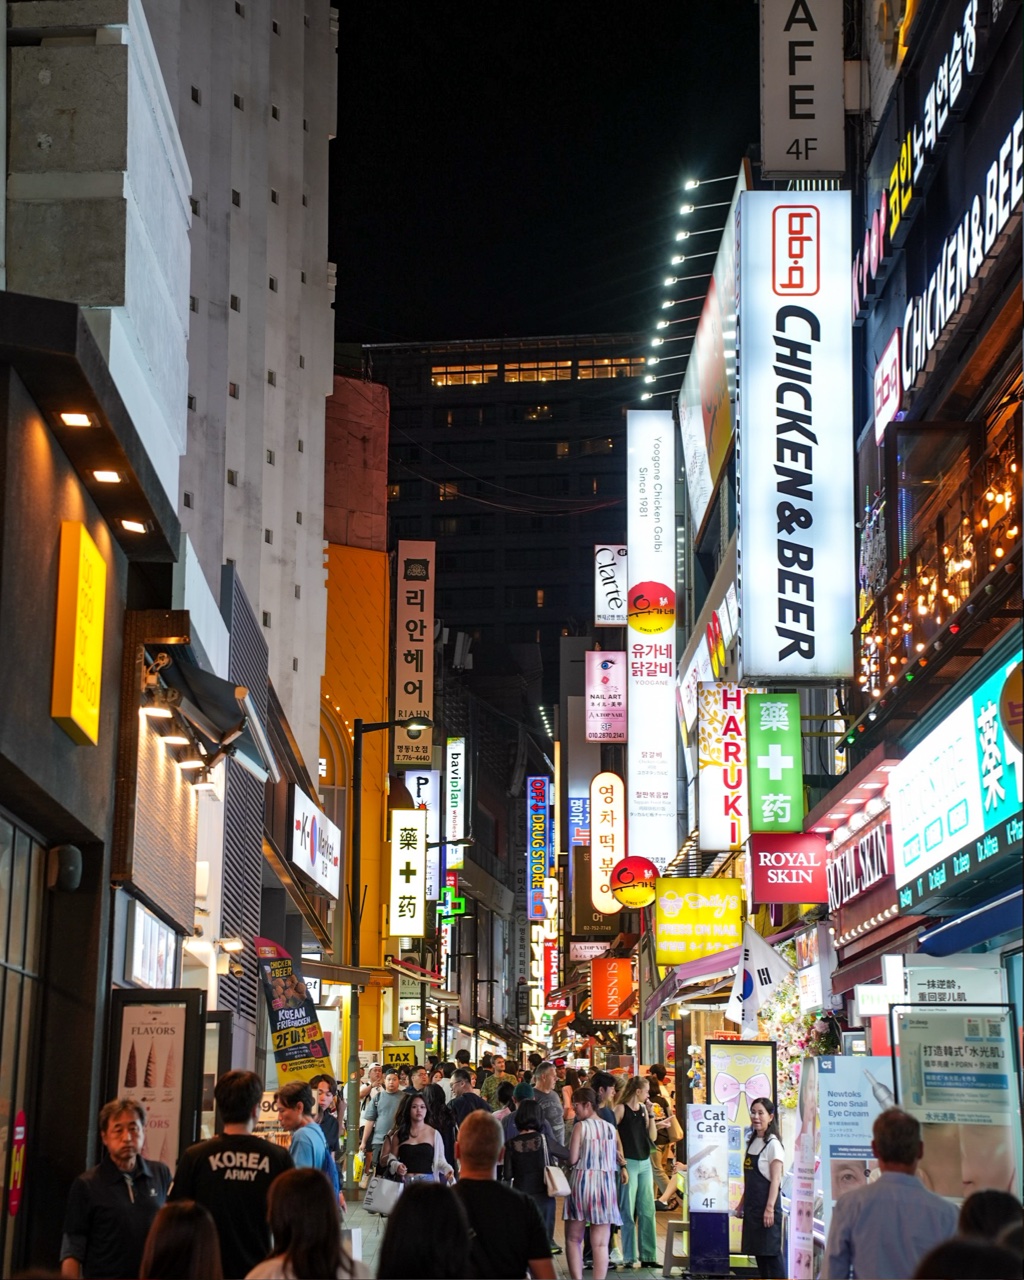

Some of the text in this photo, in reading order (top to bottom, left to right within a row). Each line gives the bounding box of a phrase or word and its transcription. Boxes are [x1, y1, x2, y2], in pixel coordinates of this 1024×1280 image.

[785, 137, 818, 161] 4F
[638, 466, 648, 518] Since 1981
[652, 437, 664, 554] Yoogane Chicken Galbi
[403, 589, 428, 704] 리안헤어
[632, 643, 673, 660] 유가네
[631, 661, 673, 678] 닭갈비
[600, 723, 612, 731] 3F
[396, 745, 429, 754] 명동1호점
[396, 754, 430, 762] T.776-4440
[721, 689, 743, 844] HARUKI
[449, 752, 462, 808] baviplan
[531, 779, 546, 803] OFF
[399, 826, 418, 851] 藥
[531, 814, 546, 848] DRUG
[758, 851, 822, 868] ROYAL
[826, 820, 890, 913] ROYAL SKIN
[531, 850, 546, 890] STORE
[767, 868, 814, 885] SKIN
[398, 894, 417, 919] 药
[658, 923, 739, 937] PRESS ON NAIL
[269, 960, 292, 969] CHICKEN
[607, 962, 619, 1017] SUNSKIN
[918, 992, 967, 1002] 重回婴儿肌
[131, 1026, 176, 1036] FLAVORS
[276, 1032, 290, 1049] 2F
[388, 1053, 410, 1062] TAX
[827, 1090, 861, 1098] Newtoks
[827, 1100, 868, 1108] Cone Snail
[703, 1109, 726, 1121] Cat
[828, 1109, 869, 1119] Eye Cream
[143, 1119, 170, 1129] VORS
[696, 1122, 727, 1134] Cafe
[208, 1151, 271, 1174] KOREA
[224, 1169, 257, 1182] ARMY
[702, 1197, 716, 1208] 4F
